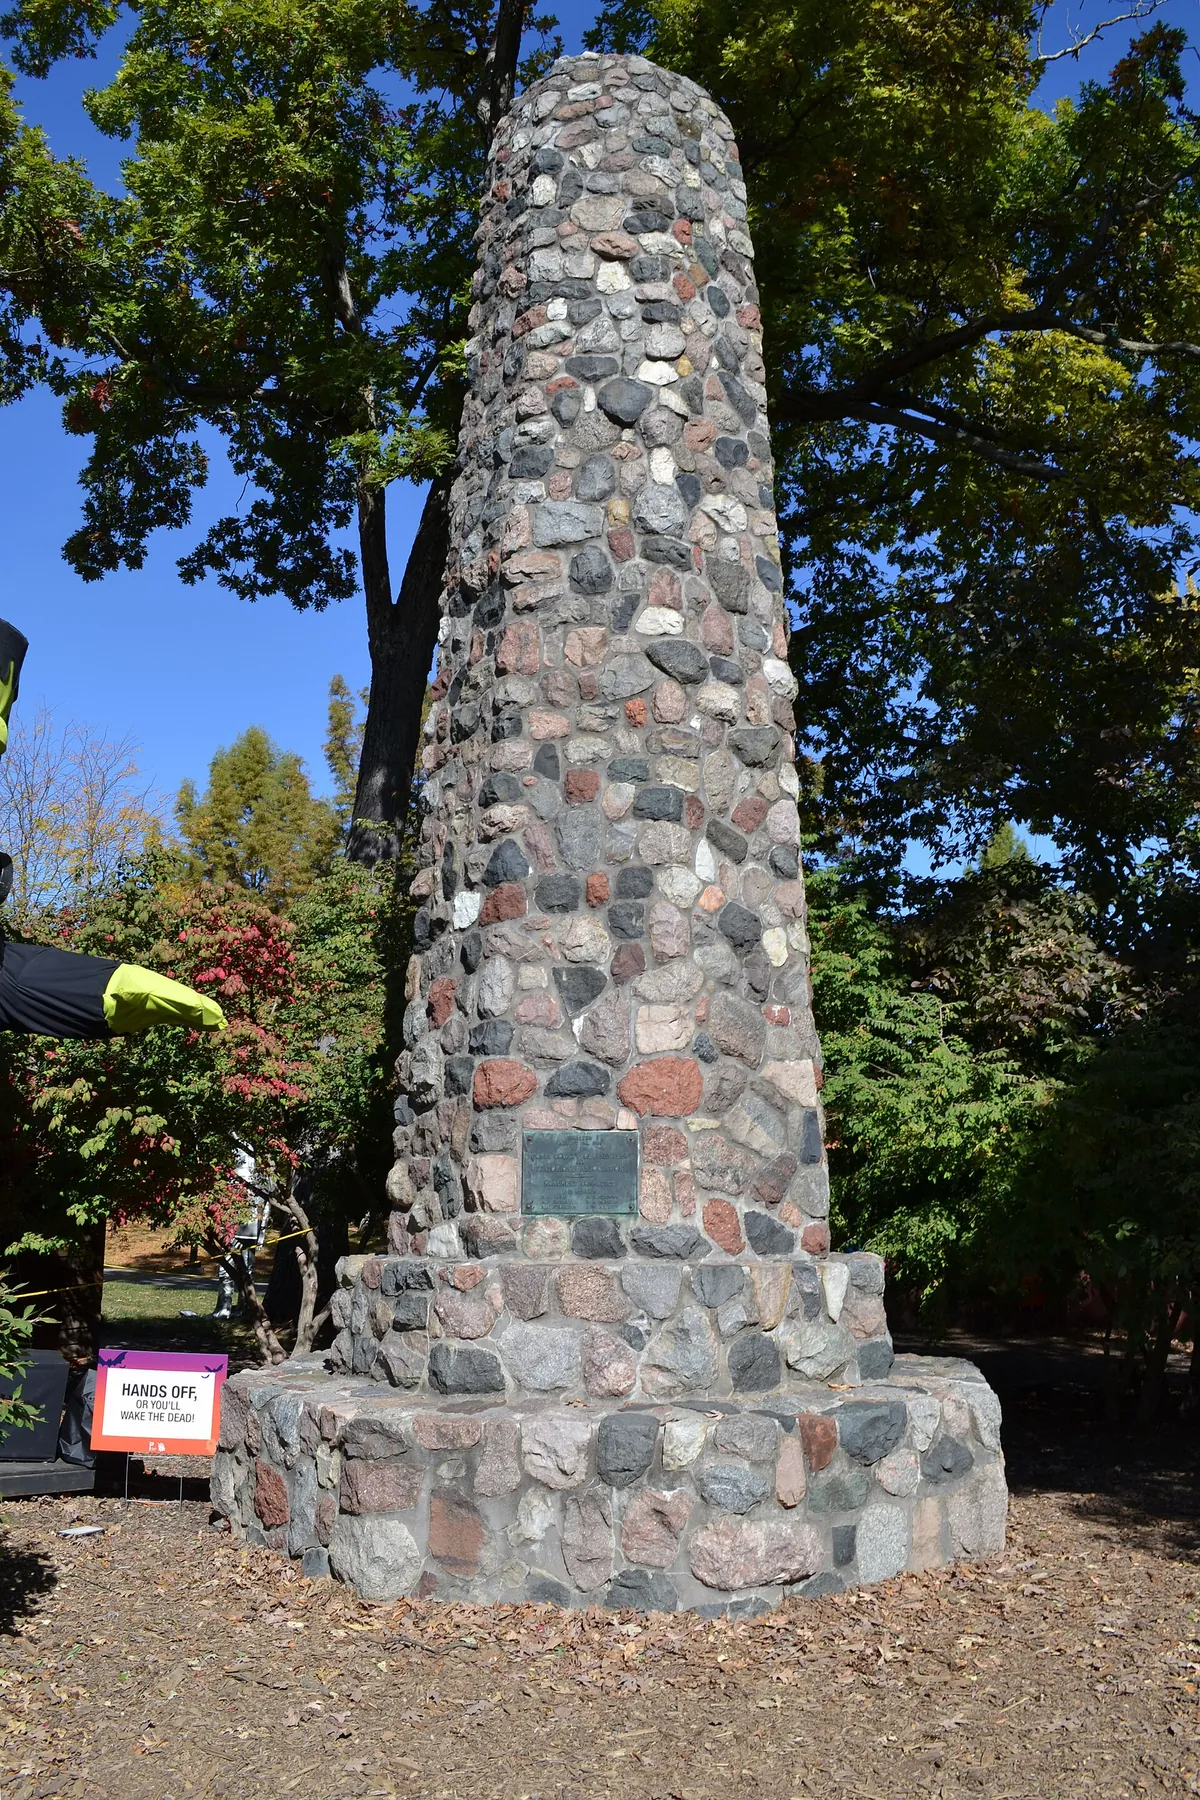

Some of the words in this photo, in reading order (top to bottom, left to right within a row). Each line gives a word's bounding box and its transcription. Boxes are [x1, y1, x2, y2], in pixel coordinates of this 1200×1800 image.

[122, 1383, 167, 1398] HANDS
[171, 1385, 198, 1402] OFF,
[136, 1399, 148, 1409] OR
[151, 1400, 181, 1411] YOU'LL
[120, 1411, 145, 1421] WAKE
[148, 1412, 165, 1422] THE
[167, 1413, 195, 1423] DEAD!
